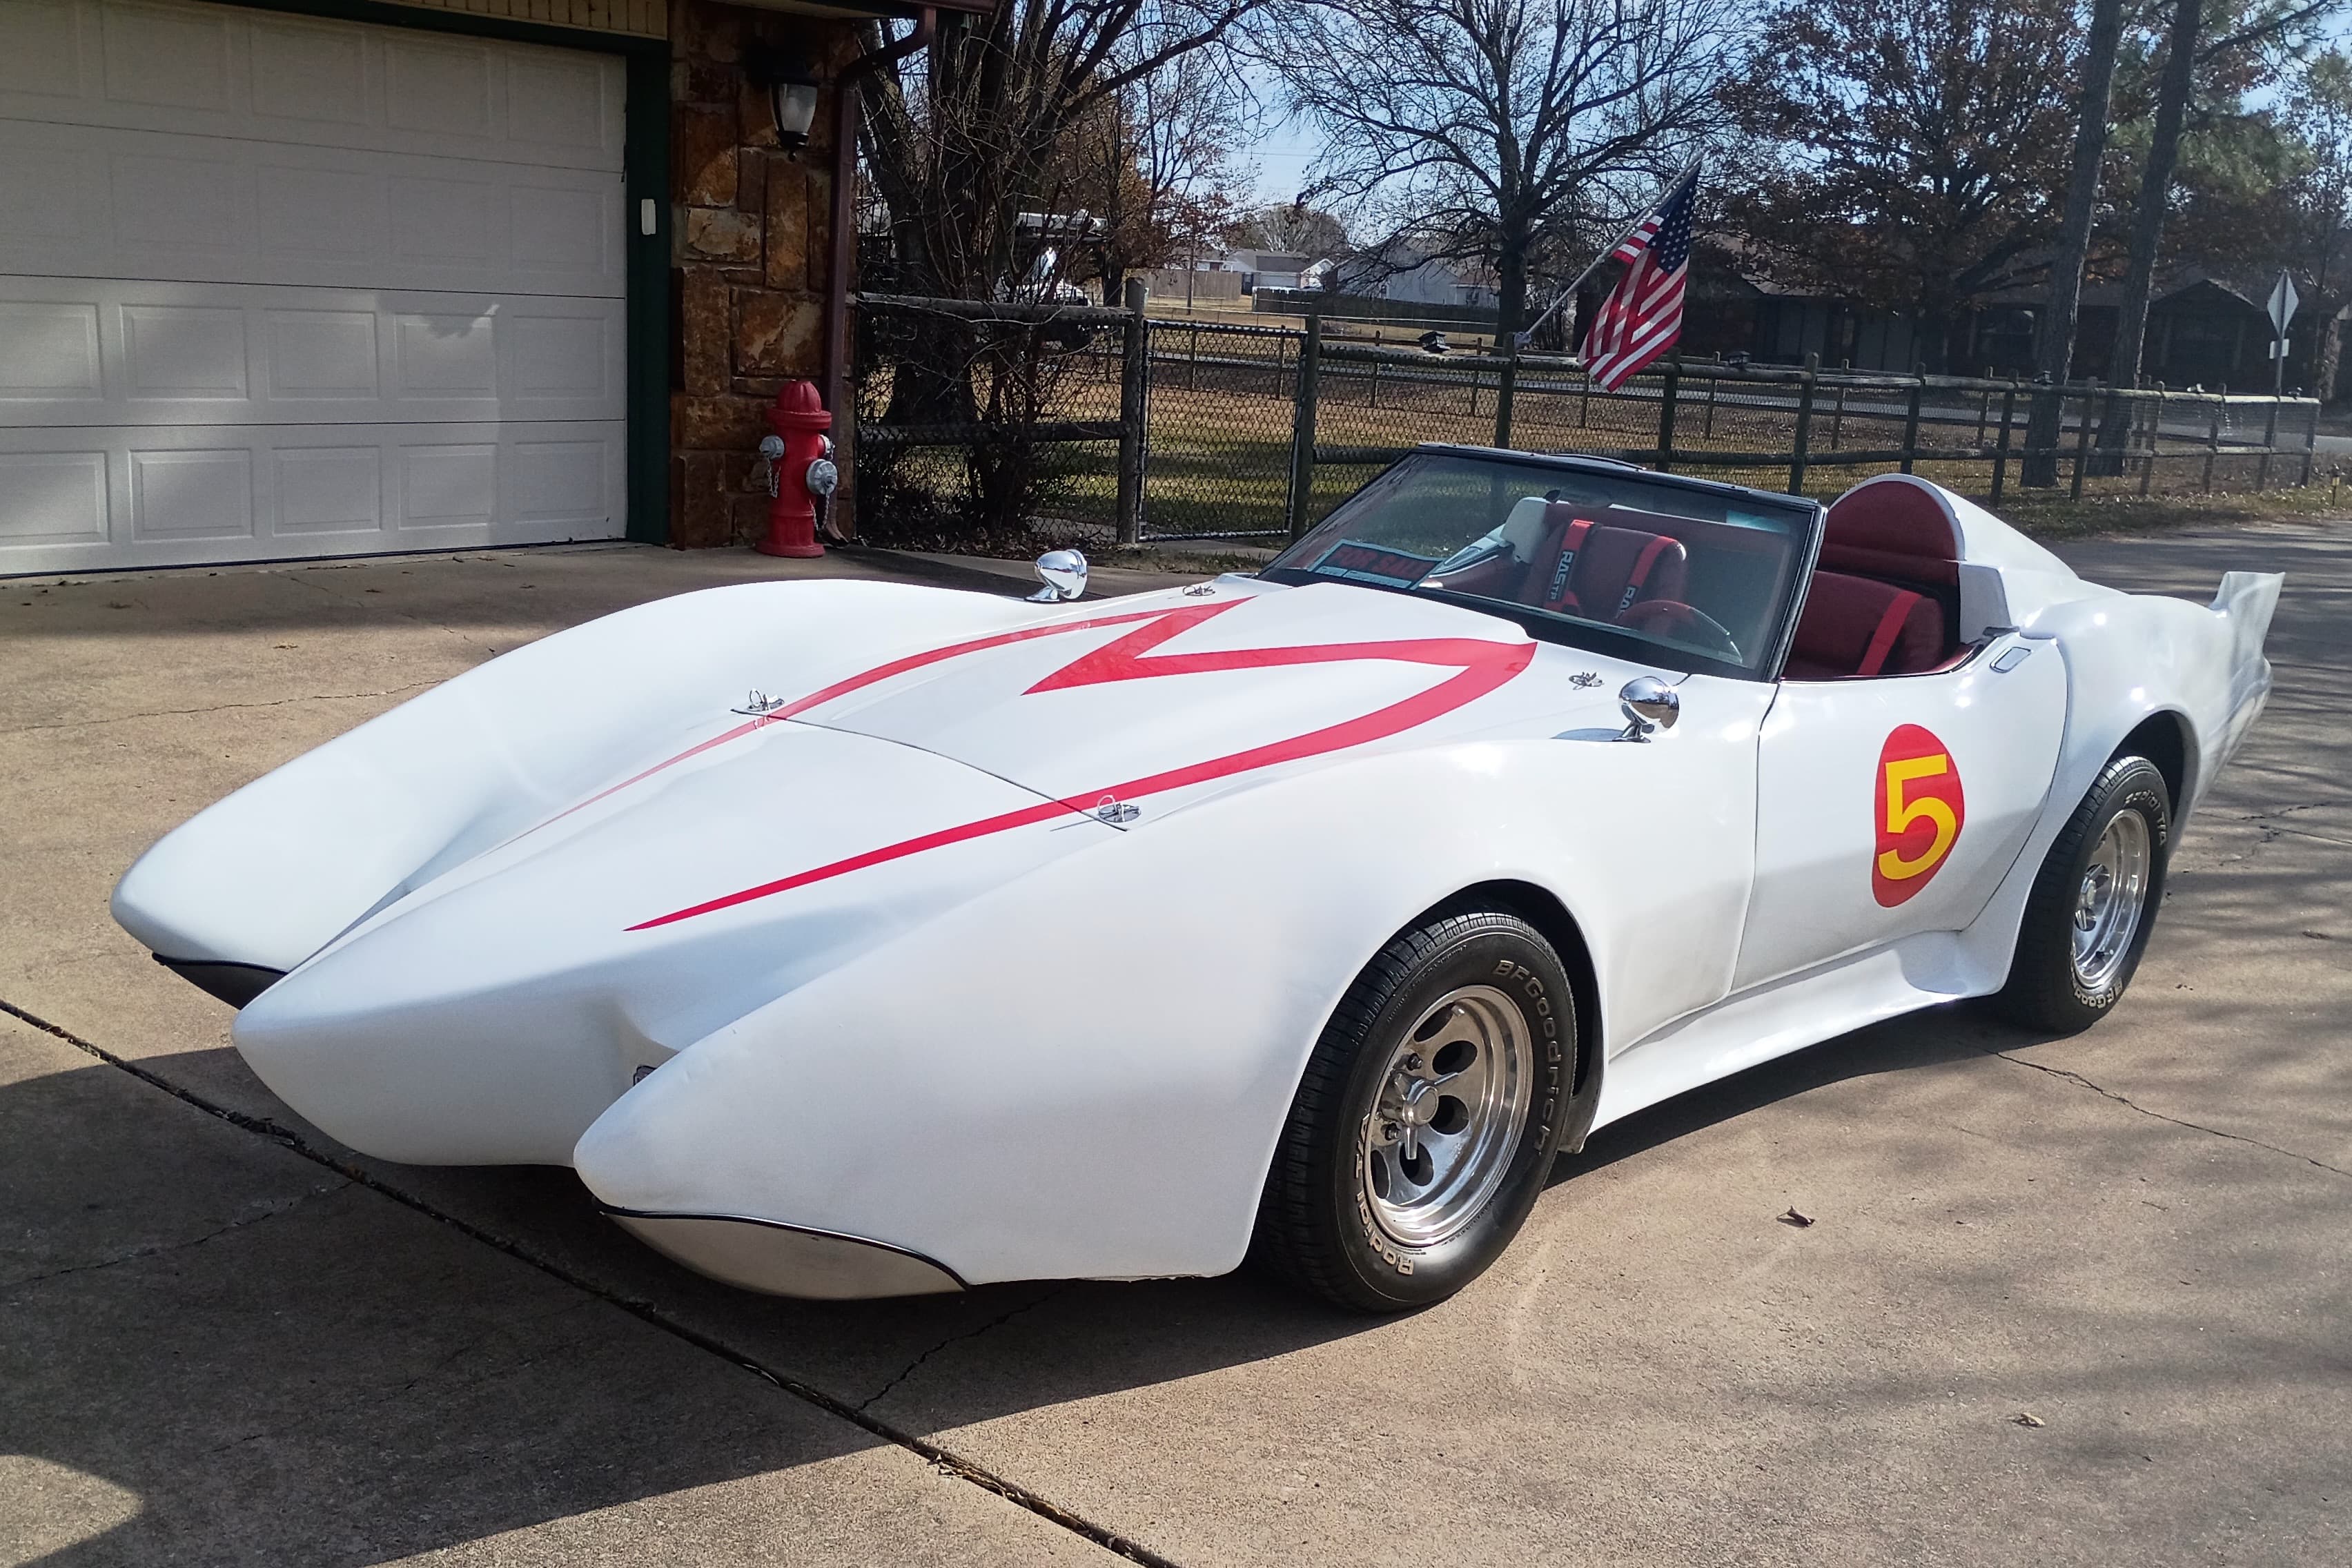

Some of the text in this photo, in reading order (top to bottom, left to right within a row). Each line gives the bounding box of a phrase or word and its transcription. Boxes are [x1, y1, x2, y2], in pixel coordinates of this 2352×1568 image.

[1326, 547, 1378, 568] FOR
[1371, 555, 1433, 579] SALE
[1878, 753, 1957, 880] 5
[1492, 960, 1561, 1156] BFGoodrich
[1356, 1191, 1414, 1275] Radial
